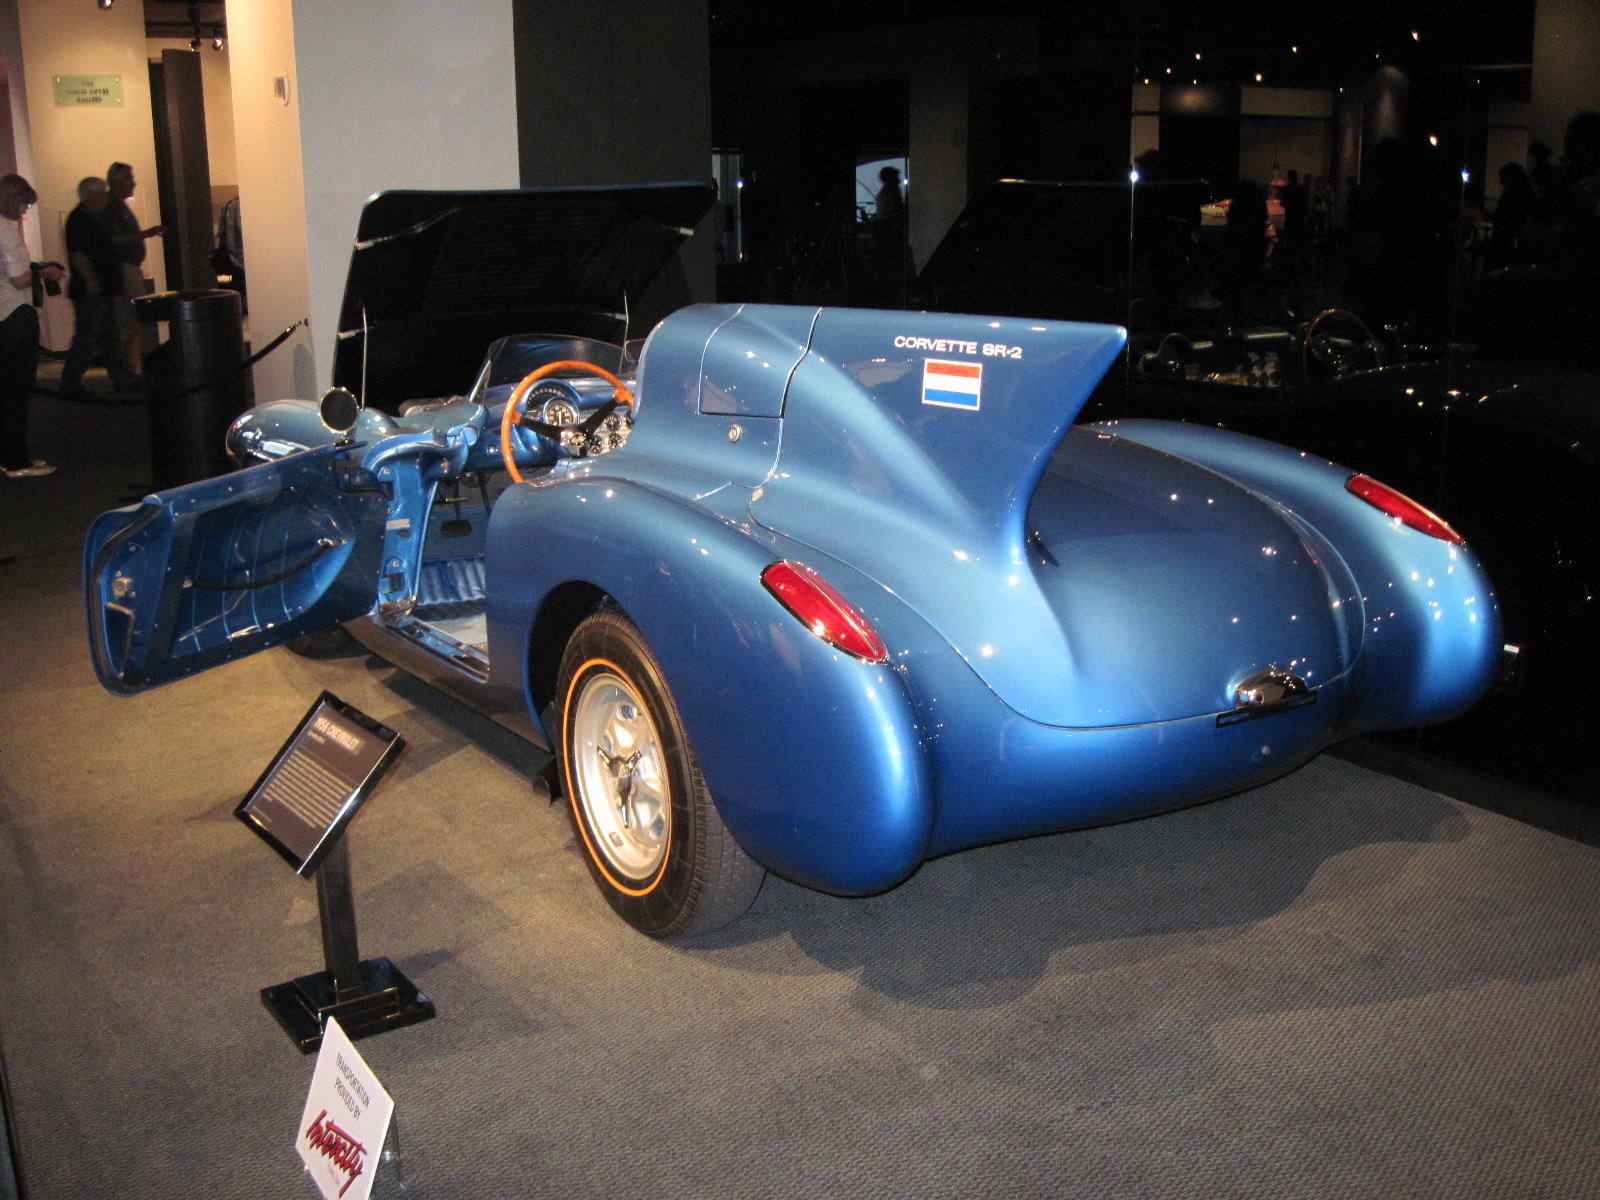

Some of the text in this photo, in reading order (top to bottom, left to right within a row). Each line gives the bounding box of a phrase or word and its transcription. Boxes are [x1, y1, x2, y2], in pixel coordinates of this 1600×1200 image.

[894, 335, 1023, 359] CORVETTE SR-2
[326, 723, 360, 751] CHEVROLET
[334, 1076, 362, 1121] PROVIDED BY
[335, 1052, 371, 1109] TRANSPORTATION
[305, 1108, 368, 1200] Intercity
